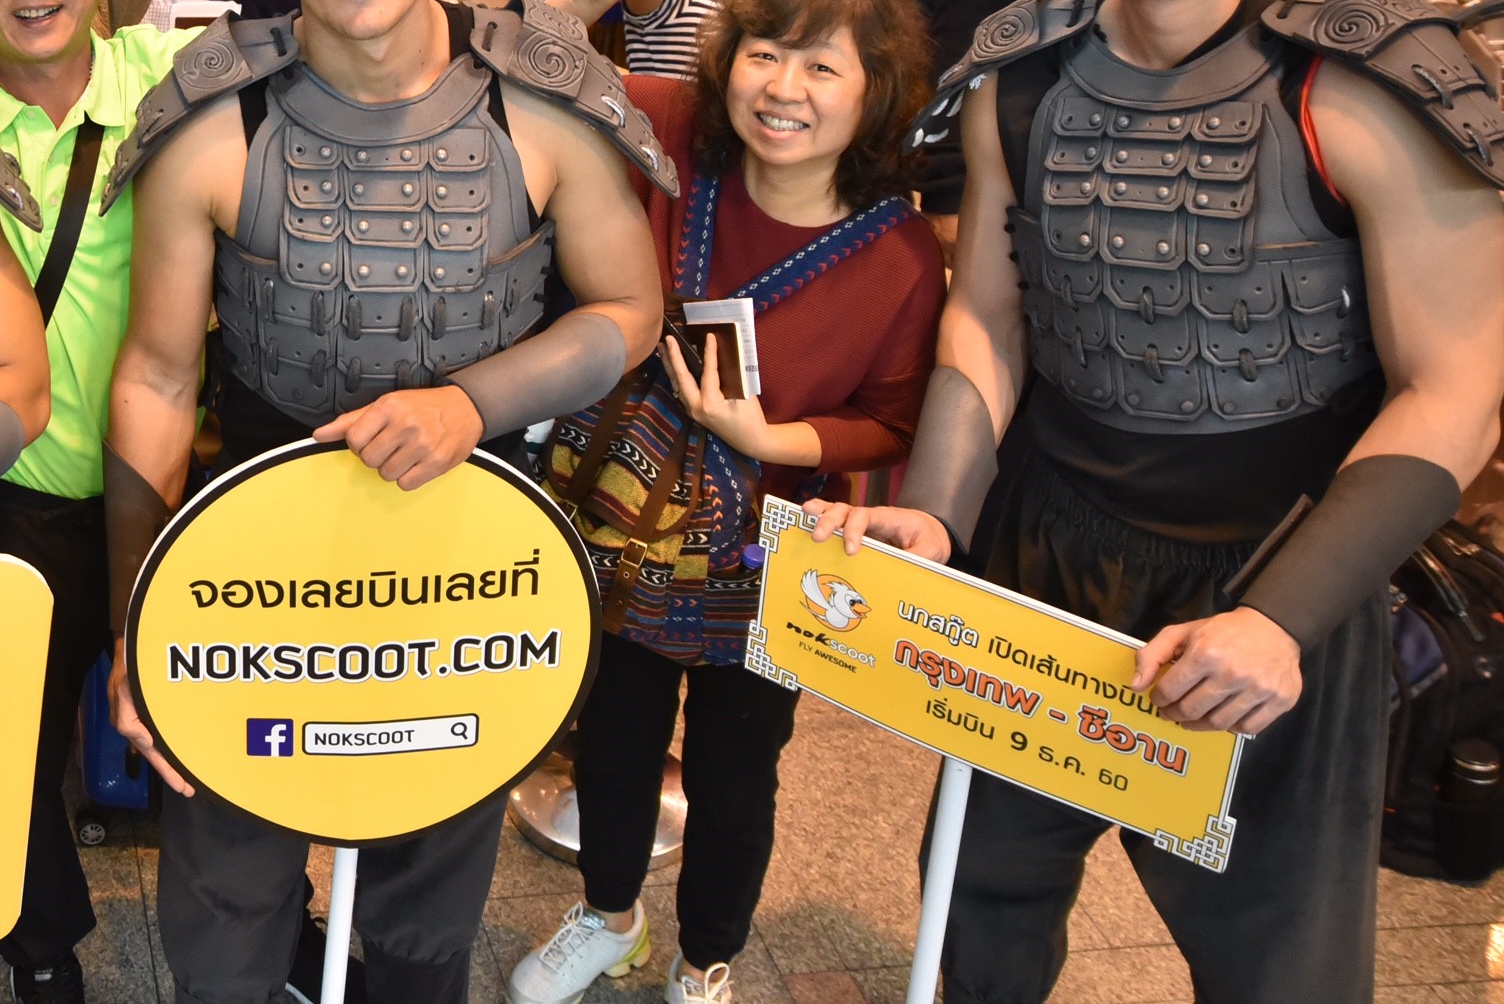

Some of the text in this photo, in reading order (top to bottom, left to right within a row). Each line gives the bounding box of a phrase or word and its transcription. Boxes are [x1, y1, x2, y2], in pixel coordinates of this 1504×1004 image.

[188, 548, 541, 608] จองเลยบินเลยที่
[167, 629, 562, 684] NOKSCOOT.COM
[786, 621, 876, 668] nokscoot
[798, 641, 858, 674] FLY AWESOME
[892, 638, 1042, 718] กรุงเทพ
[313, 729, 416, 748] NOKSCOOT
[925, 697, 1129, 792] เริ่มบิน 9 ธ.ค. 60
